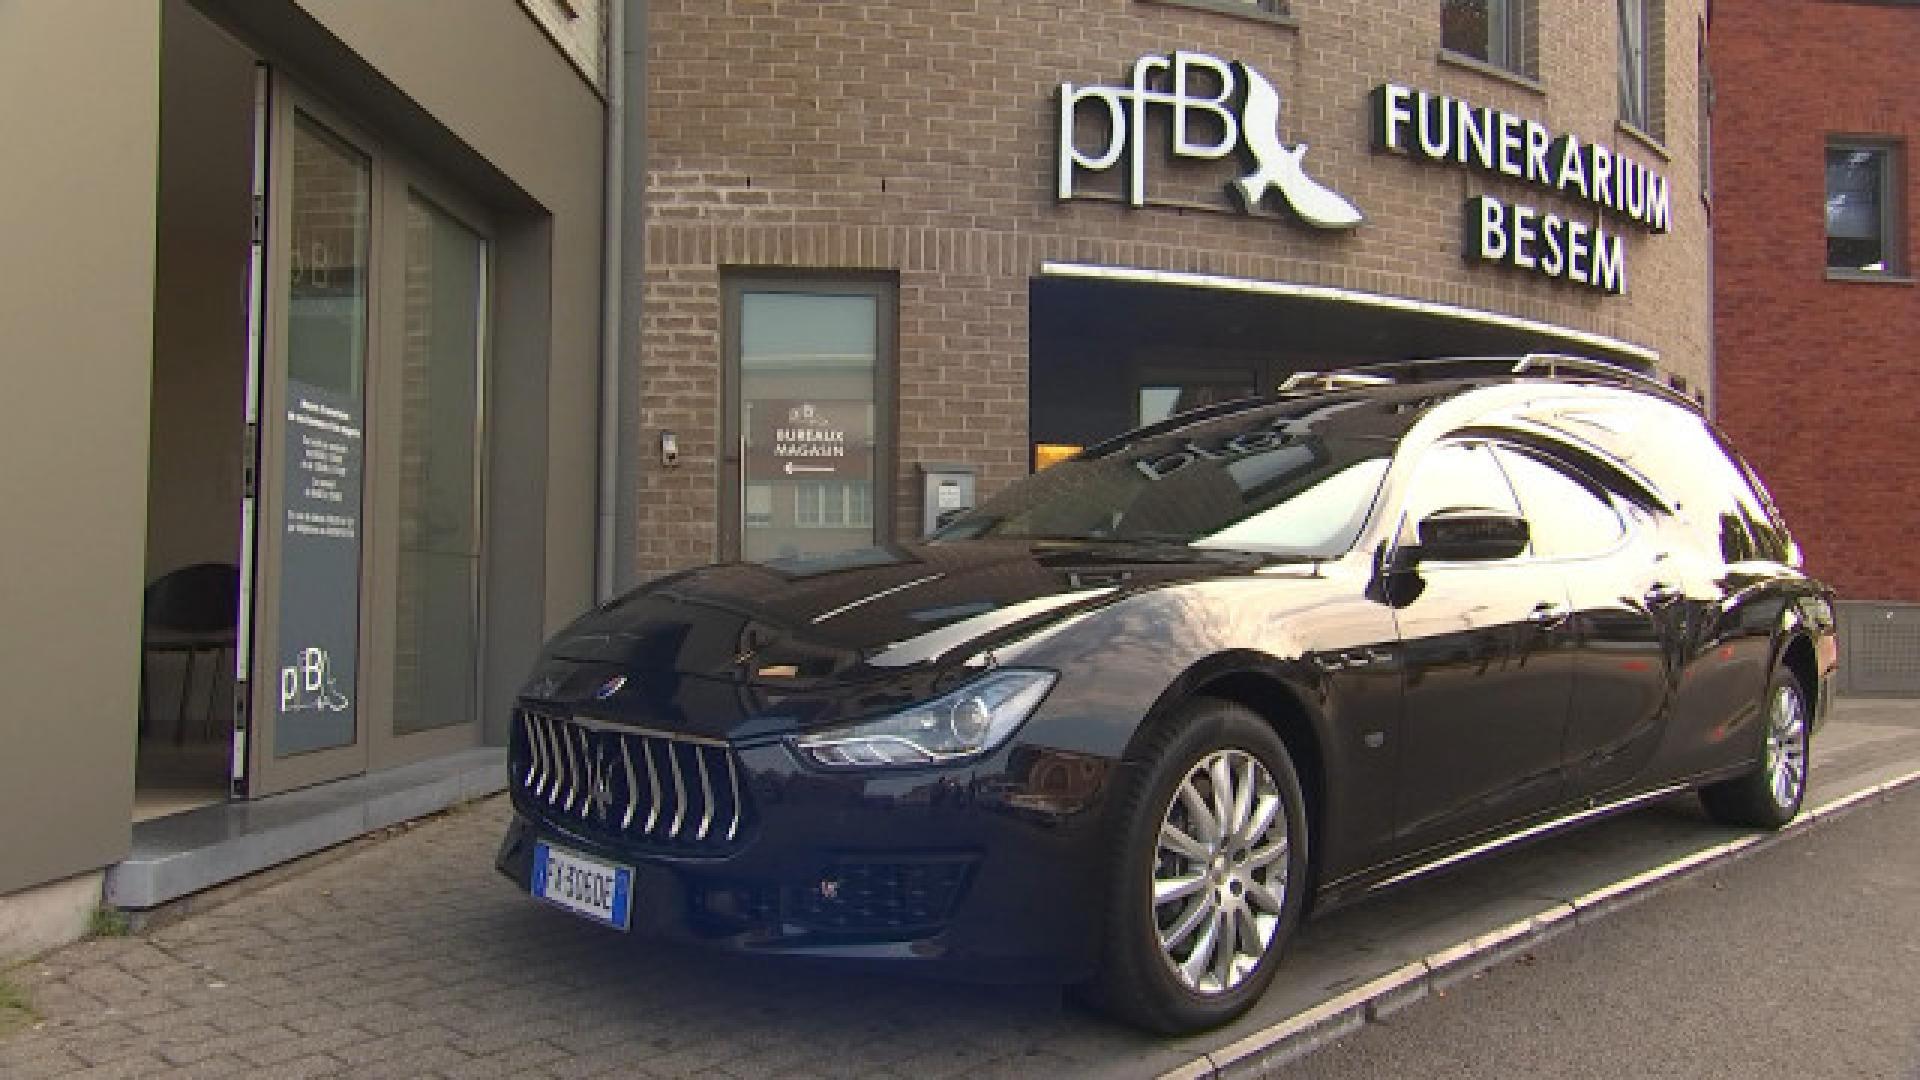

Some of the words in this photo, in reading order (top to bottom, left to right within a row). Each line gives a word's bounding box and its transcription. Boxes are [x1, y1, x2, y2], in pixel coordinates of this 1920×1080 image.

[1381, 83, 1672, 233] FUNERARIUM
[1480, 196, 1626, 294] BESEM
[774, 443, 844, 457] MAGASIN
[776, 428, 844, 442] BUREAUX
